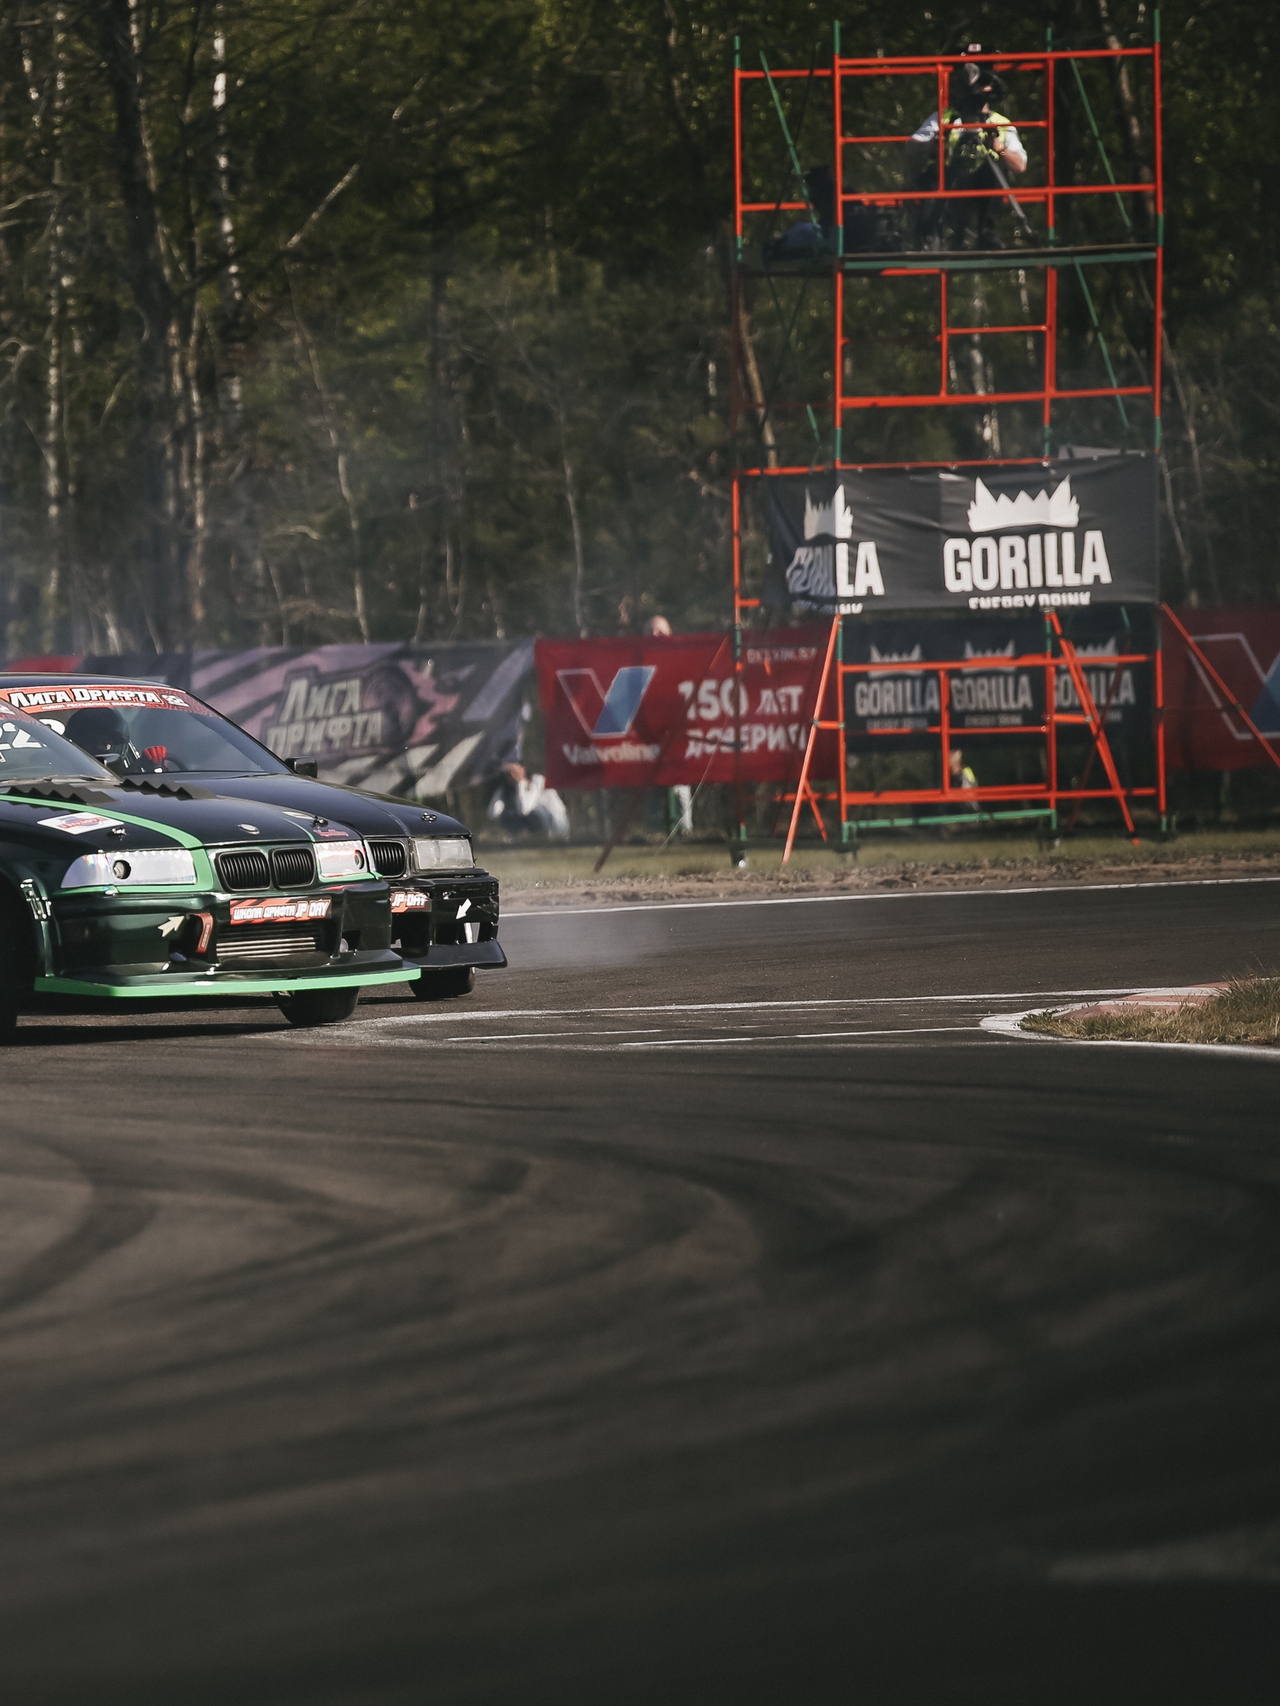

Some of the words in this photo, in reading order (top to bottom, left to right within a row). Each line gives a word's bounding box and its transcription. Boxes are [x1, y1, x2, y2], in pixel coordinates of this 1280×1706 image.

[944, 530, 1112, 593] GORILLA
[678, 677, 749, 720] 150
[855, 677, 939, 716] GORILLA
[951, 673, 1033, 710] GORILLA
[1054, 669, 1136, 706] OILLA
[562, 741, 661, 765] Valvoline
[233, 907, 262, 921] ШКОЛА
[296, 901, 308, 918] JP
[309, 899, 330, 917] DAY
